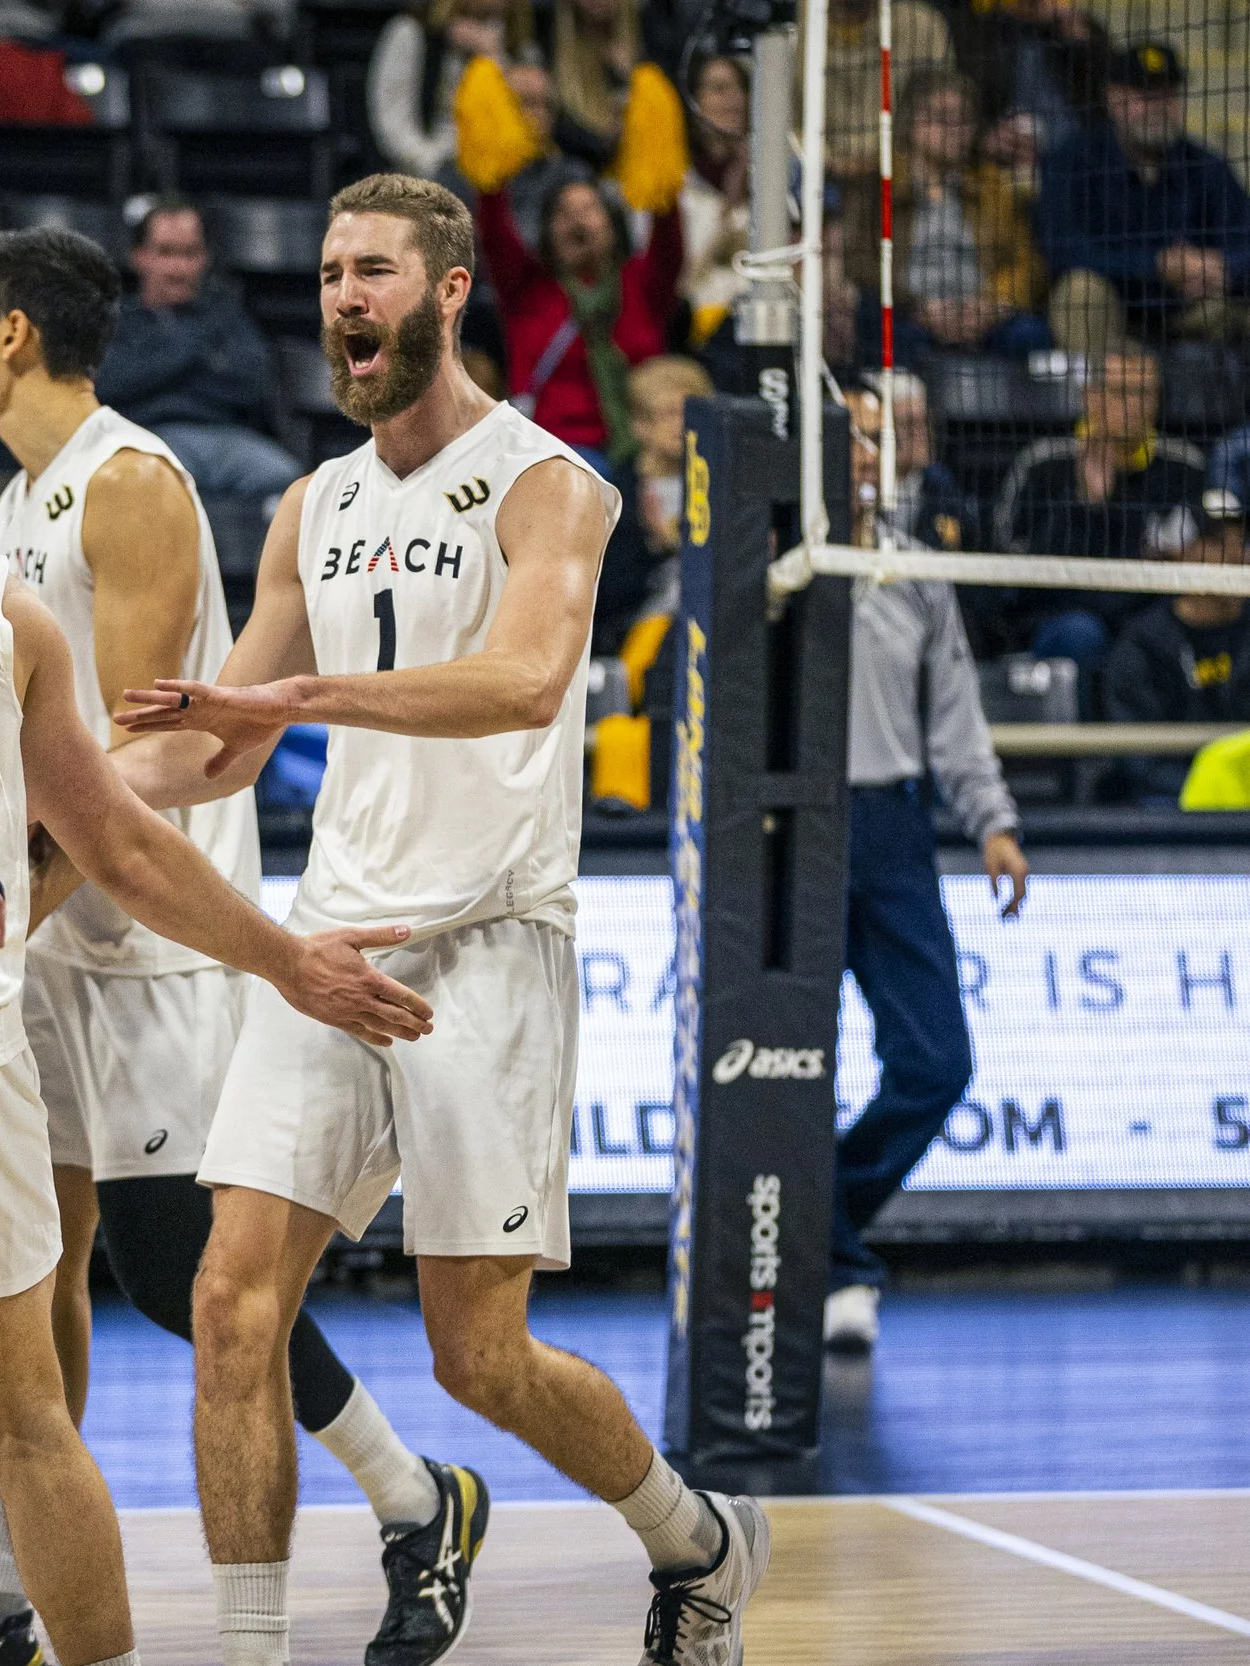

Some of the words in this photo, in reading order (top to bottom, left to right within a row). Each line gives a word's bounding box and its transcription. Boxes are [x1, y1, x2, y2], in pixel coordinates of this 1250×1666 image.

[320, 536, 464, 582] BEACH
[373, 588, 397, 673] 1
[1044, 946, 1126, 1013] IS
